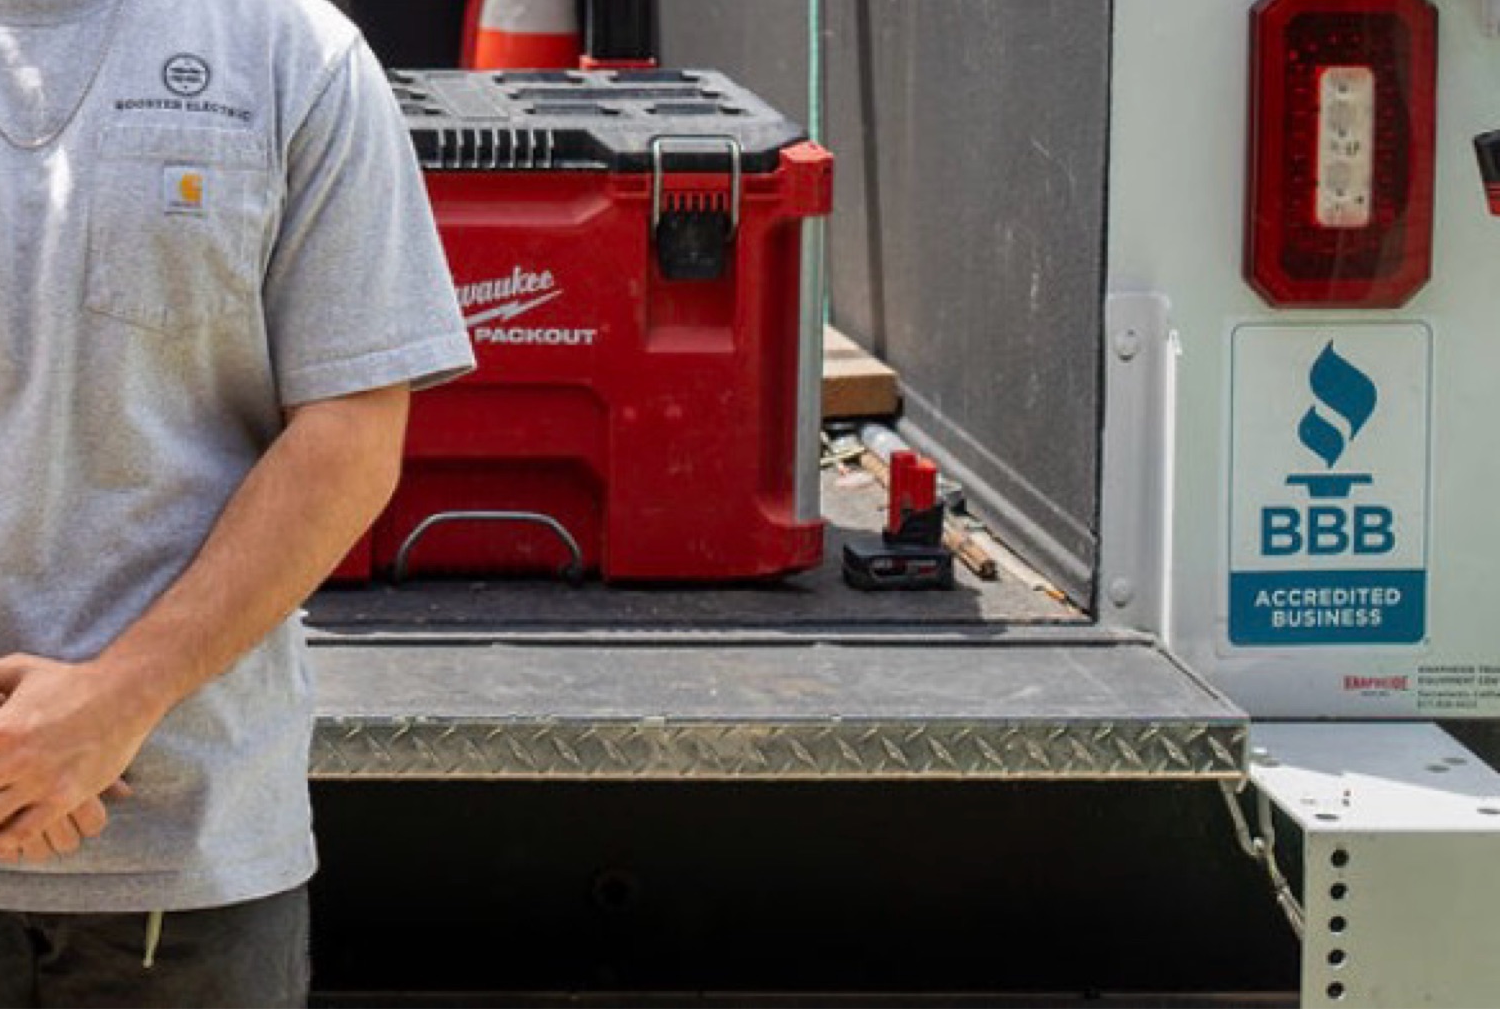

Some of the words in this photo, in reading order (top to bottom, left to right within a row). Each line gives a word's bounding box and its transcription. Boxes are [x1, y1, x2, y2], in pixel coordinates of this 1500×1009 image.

[115, 99, 182, 110] ROOSTER
[187, 101, 251, 121] ELECTRIC
[457, 266, 554, 306] waukee
[475, 328, 596, 344] PACKOUT
[1260, 505, 1395, 556] BBB
[1255, 588, 1400, 607] ACCREDITED
[1272, 608, 1382, 627] BUSINESS
